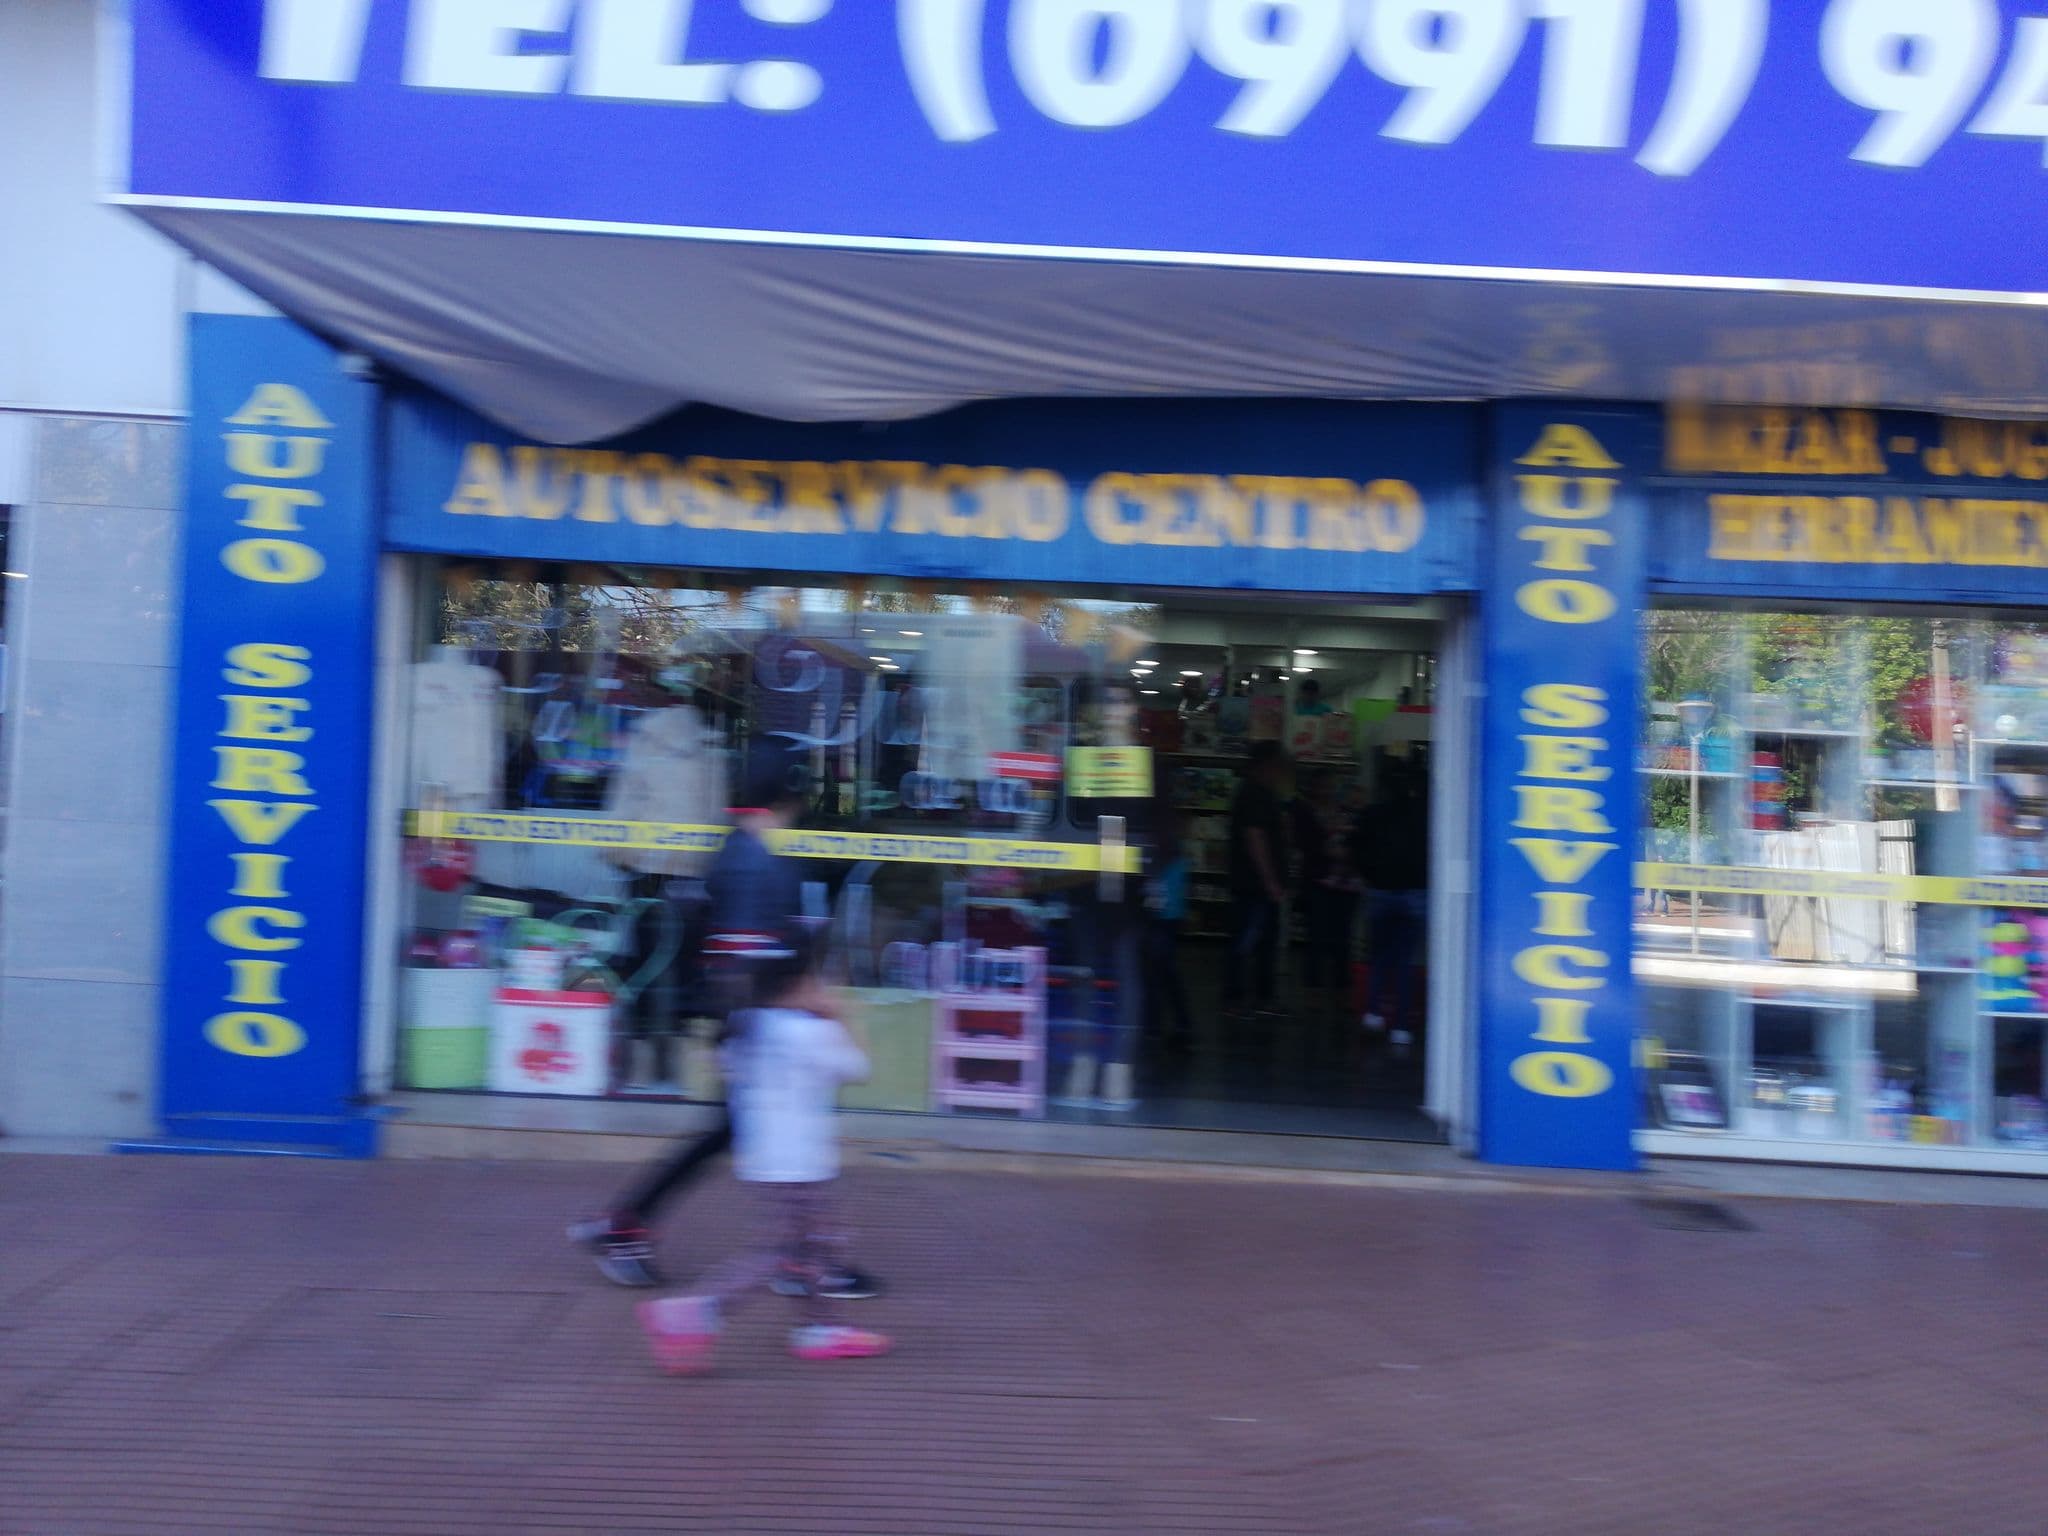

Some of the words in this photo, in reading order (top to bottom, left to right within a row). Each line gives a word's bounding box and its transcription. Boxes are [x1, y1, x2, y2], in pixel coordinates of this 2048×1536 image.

[896, 0, 1770, 176] (0991)
[221, 383, 336, 583] AUTO
[1084, 471, 1424, 552] CENTRO
[1513, 423, 1624, 624] AUTO
[202, 643, 321, 1058] SERVICIO
[1507, 684, 1620, 1098] SERVICIO
